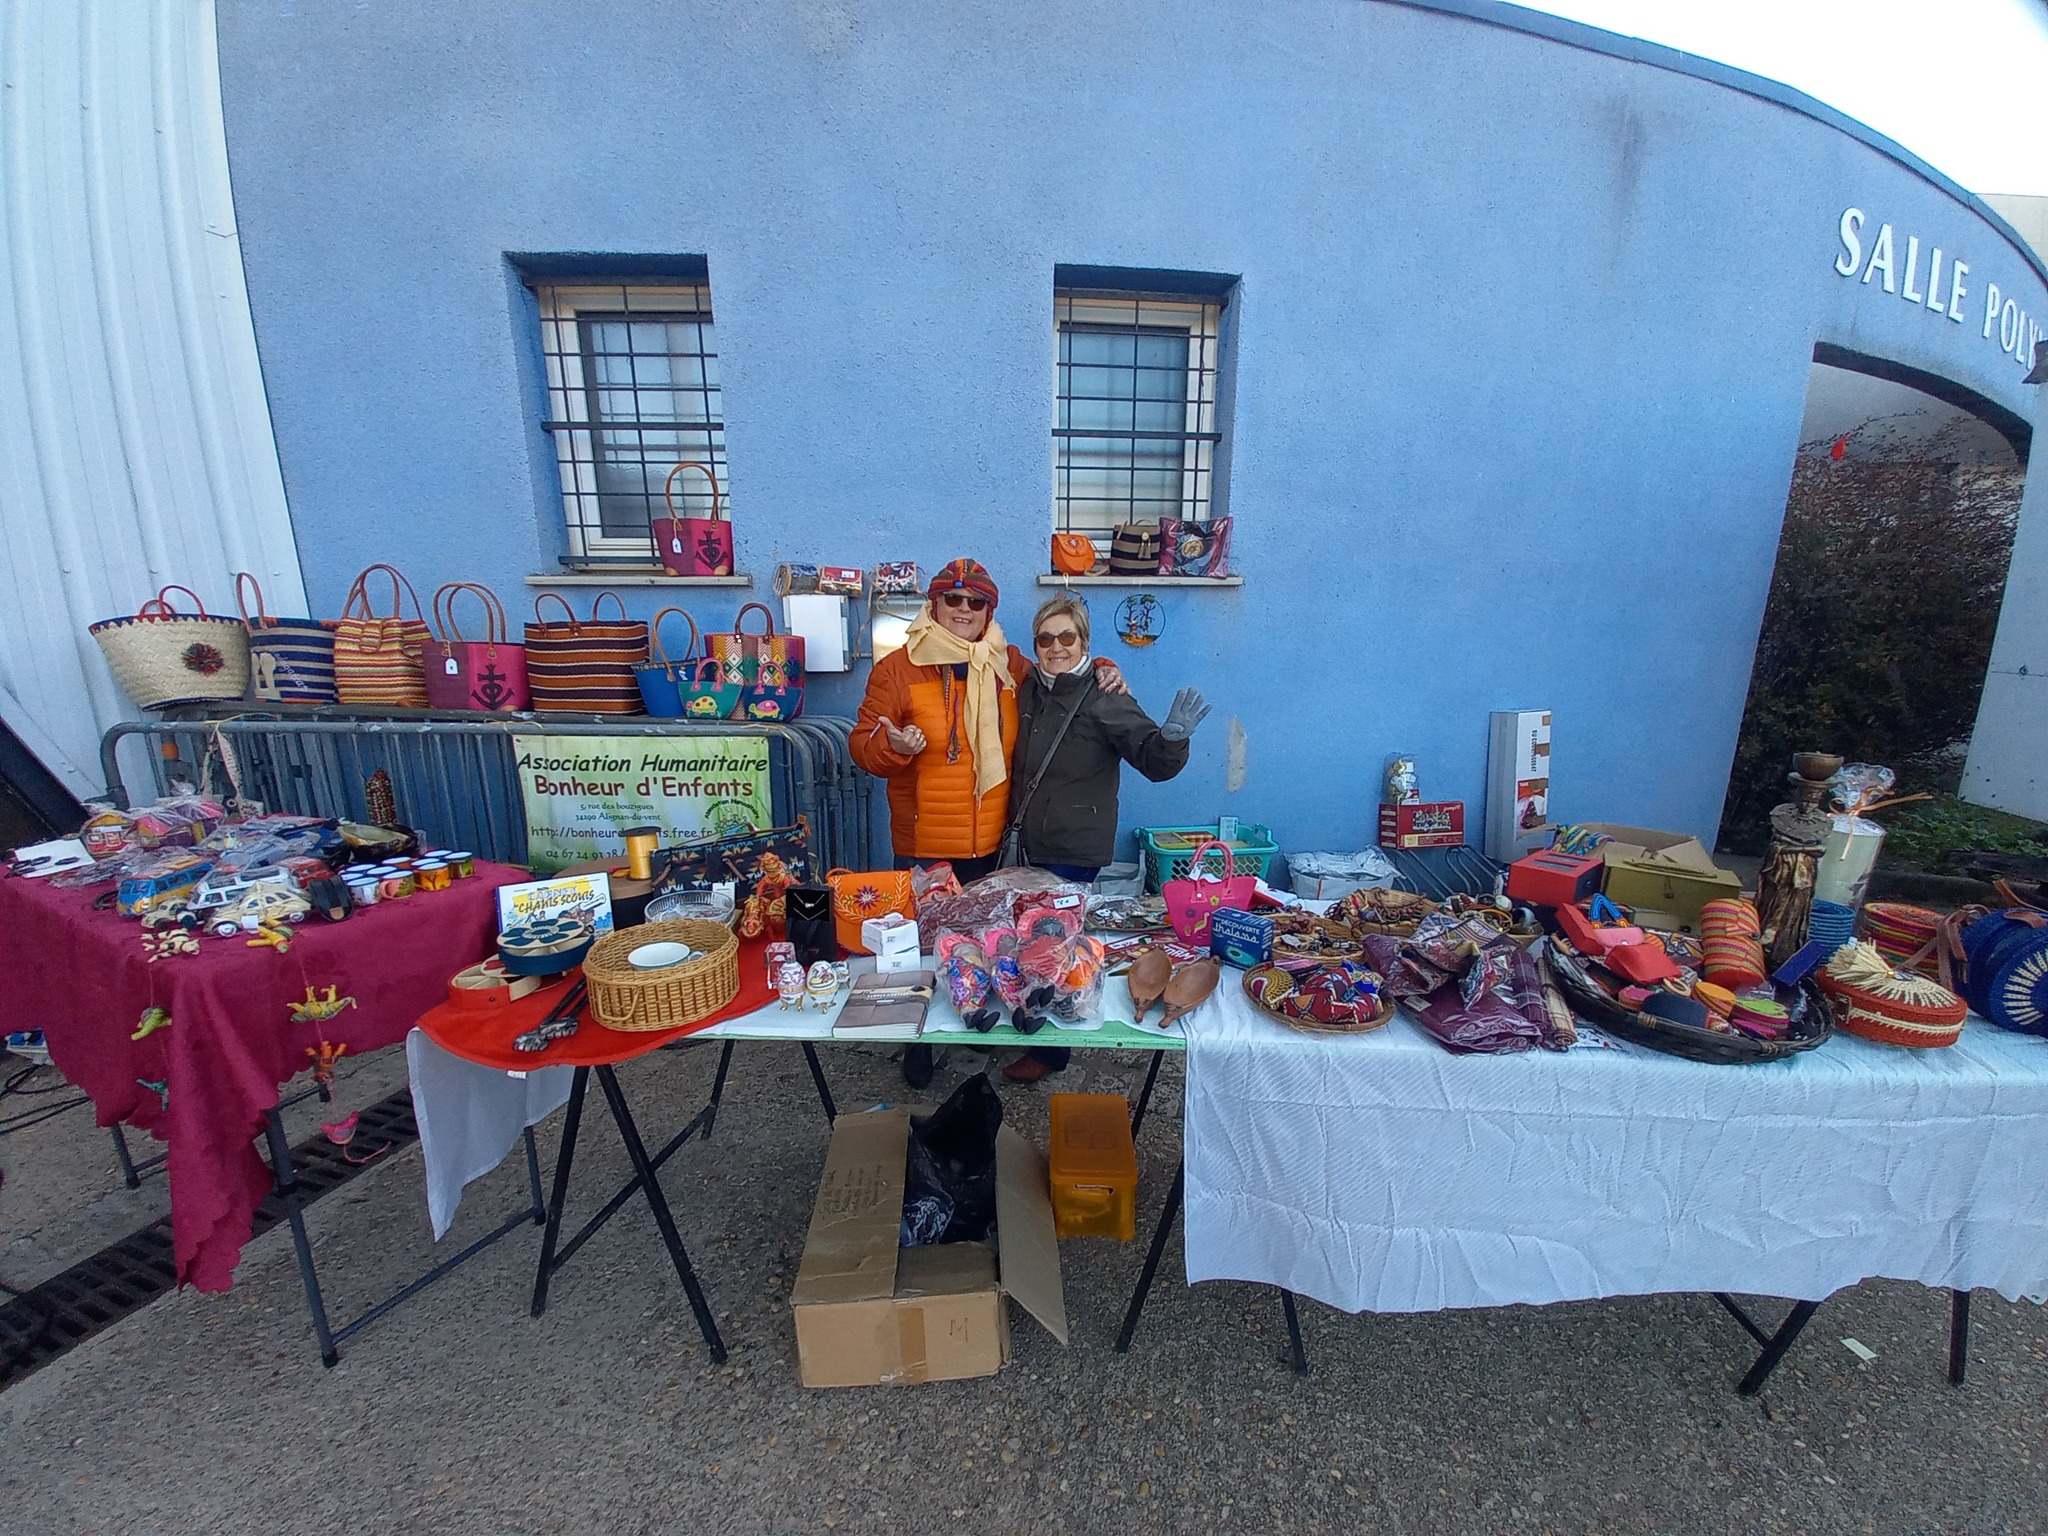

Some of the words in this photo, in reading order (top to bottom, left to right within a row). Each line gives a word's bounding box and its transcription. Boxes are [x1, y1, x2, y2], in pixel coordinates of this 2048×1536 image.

[1834, 207, 1970, 323] SALLE
[1982, 282, 2044, 371] POLY
[518, 753, 631, 772] Association
[640, 754, 768, 772] Humanitaire
[534, 775, 625, 796] Bonheur
[636, 776, 753, 797] d'Enfants
[602, 802, 615, 810] des
[616, 802, 654, 812] bouzigues
[599, 812, 661, 822] Alignan-du-vent
[546, 850, 559, 859] 04
[562, 848, 574, 859] 67
[577, 851, 589, 860] 24
[518, 897, 559, 914] CHANTS
[560, 889, 595, 906] SCOUTS
[1213, 922, 1260, 944] thalassa
[1221, 919, 1260, 934] DÉCOUVERTE
